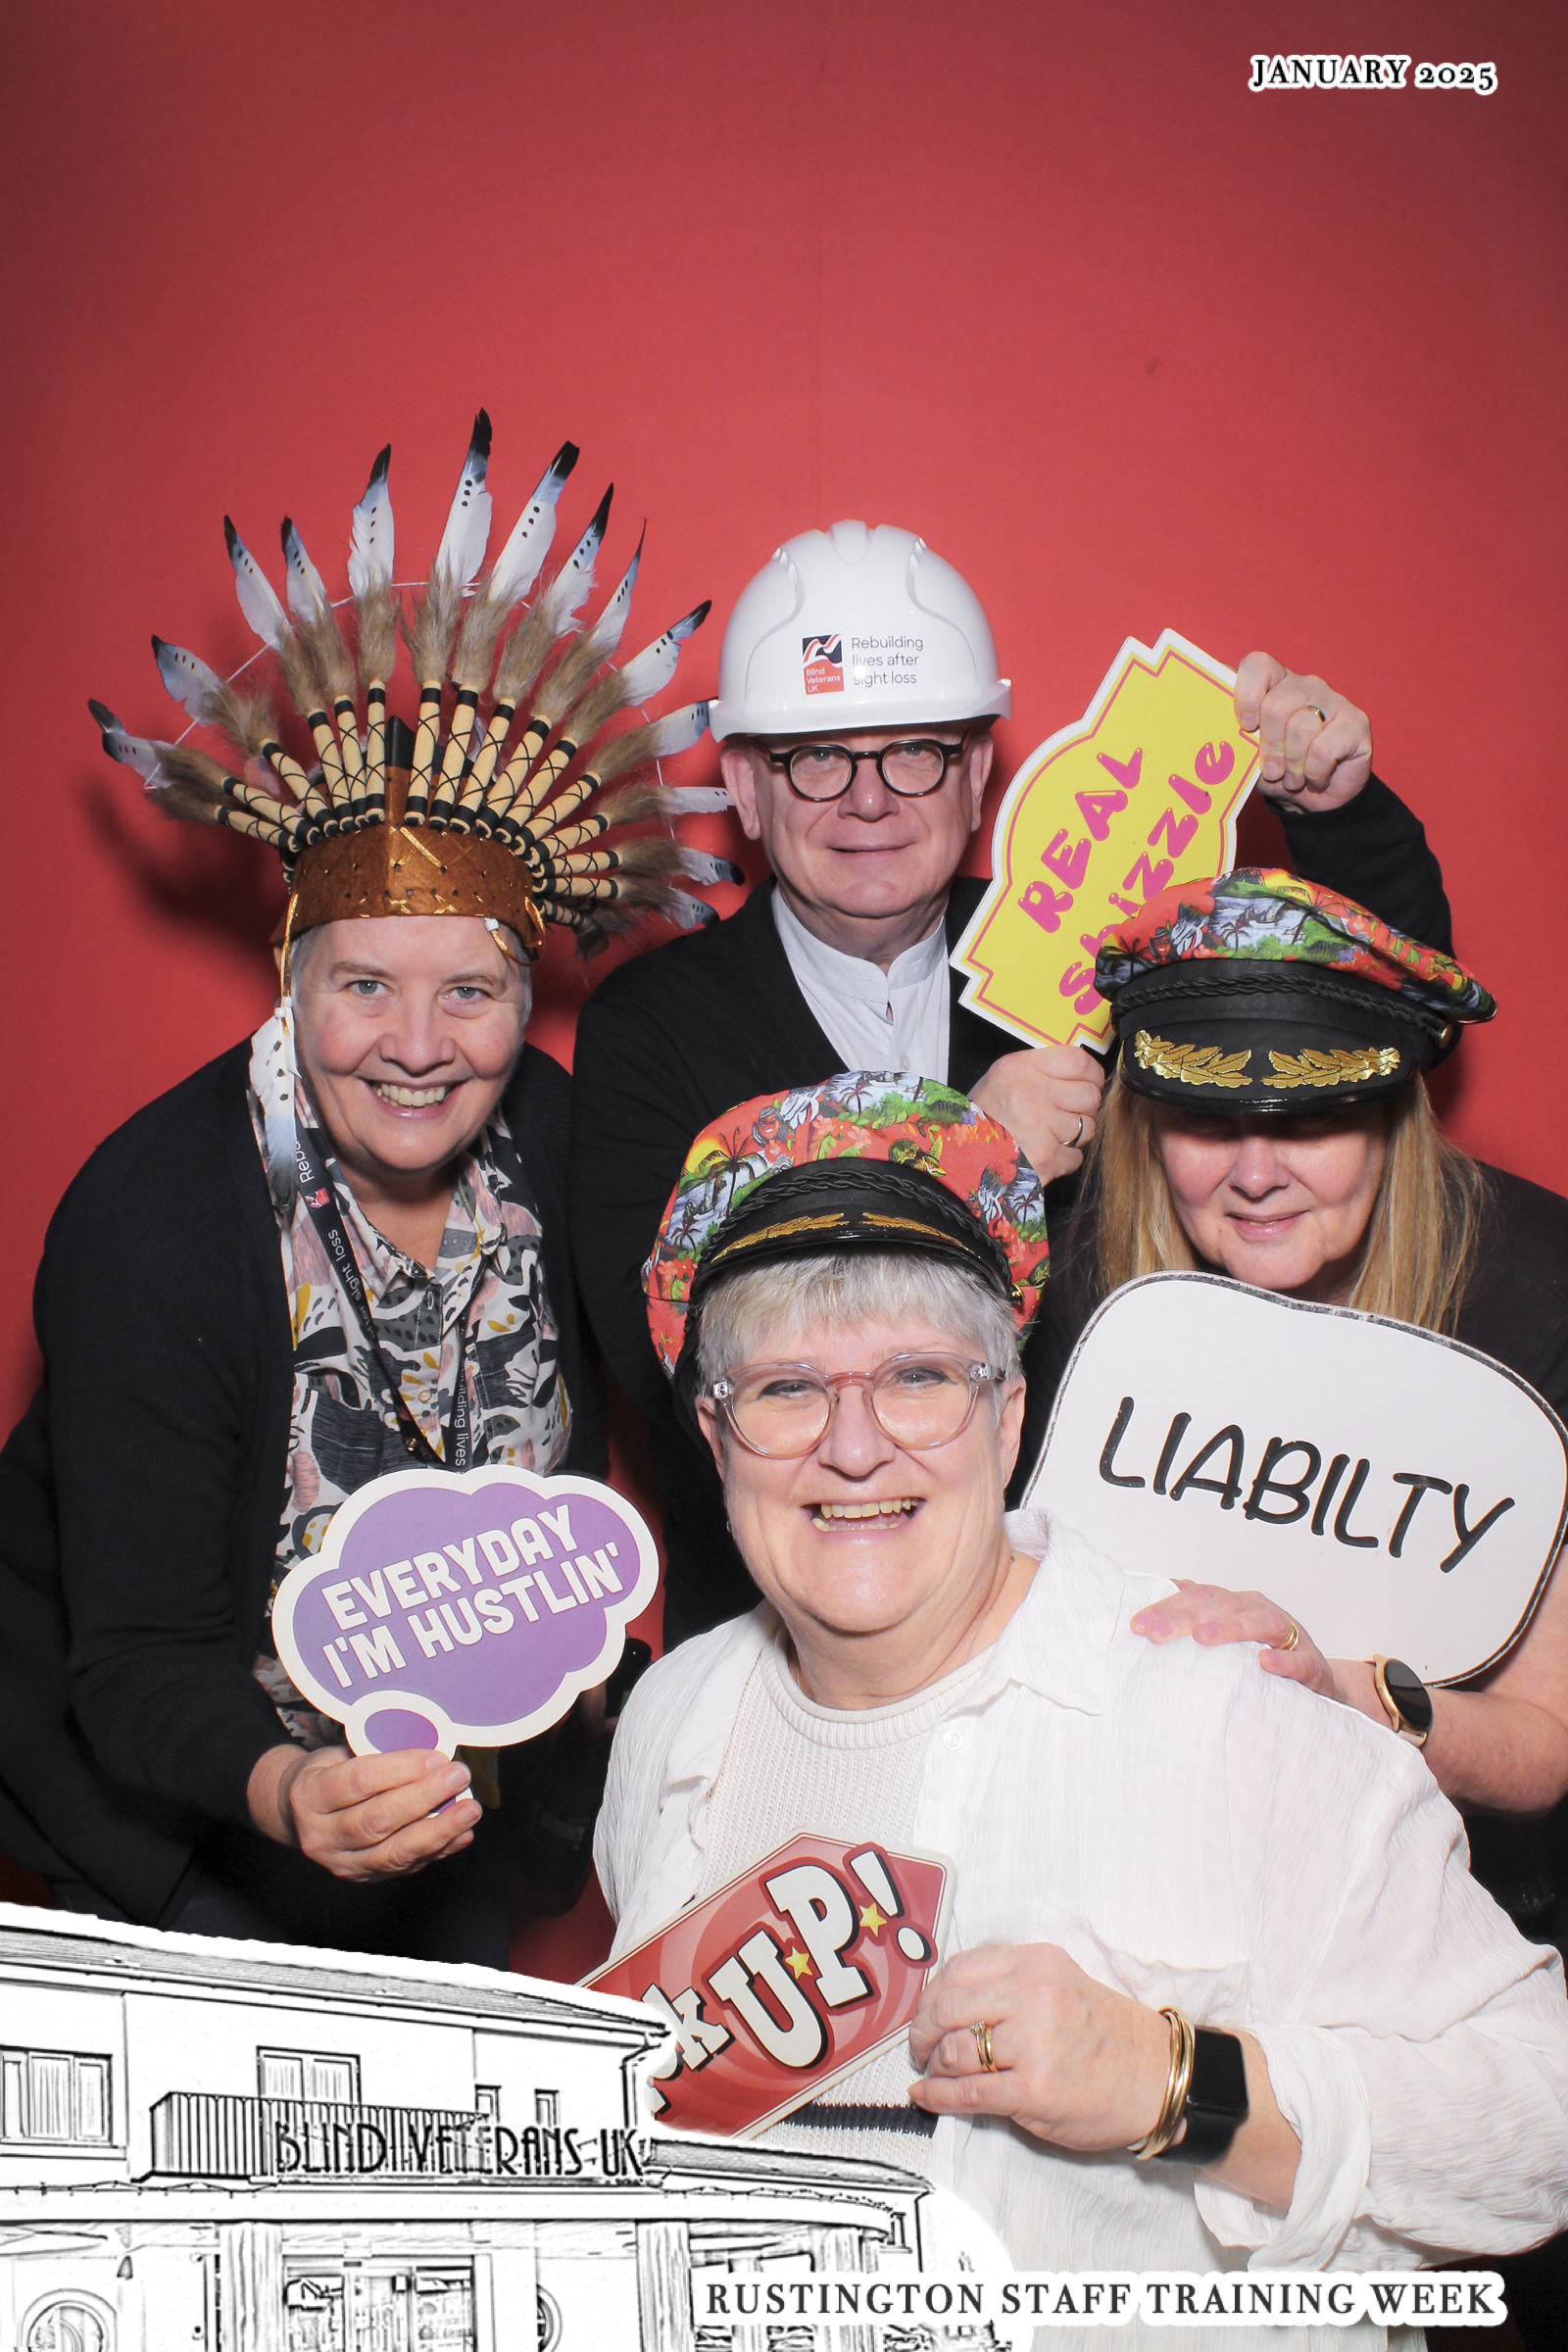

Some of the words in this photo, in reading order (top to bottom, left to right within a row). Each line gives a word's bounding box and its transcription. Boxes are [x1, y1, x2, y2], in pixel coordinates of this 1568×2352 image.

[851, 635, 924, 652] Rebuilding
[852, 654, 884, 667] lives
[886, 652, 920, 666] after
[806, 666, 826, 677] Blind
[806, 674, 842, 685] Veterans
[891, 670, 918, 684] loss
[807, 684, 819, 694] UK
[1016, 746, 1144, 934] REAL
[328, 1229, 347, 1262] loss
[341, 1262, 363, 1301] sight
[455, 1435, 469, 1467] lives
[1099, 1396, 1516, 1574] LIABILTY
[320, 1503, 578, 1632] EVERYDAY
[321, 1624, 407, 1689] I'M
[407, 1542, 623, 1659] HUSTLIN'
